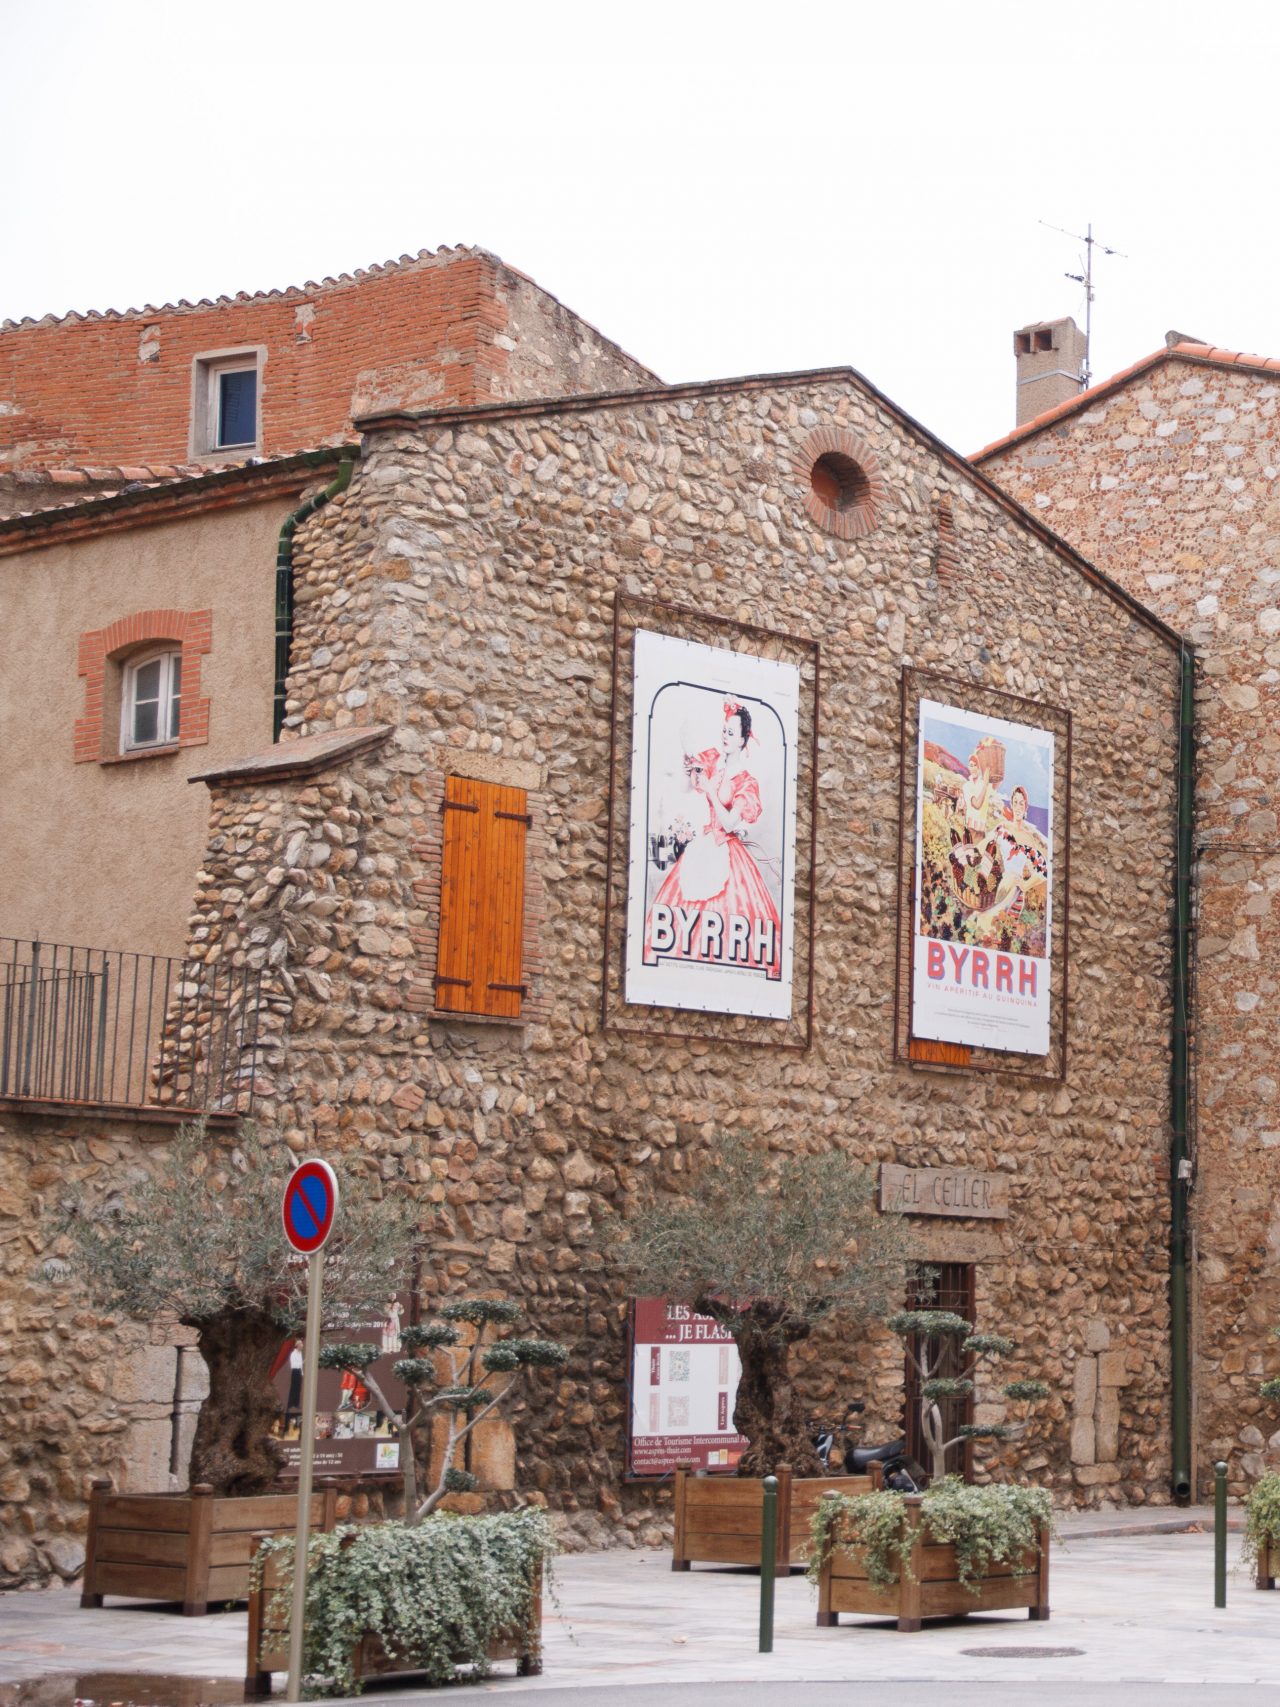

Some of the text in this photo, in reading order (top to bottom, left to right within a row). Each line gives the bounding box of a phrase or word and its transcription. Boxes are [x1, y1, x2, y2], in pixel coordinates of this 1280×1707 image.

[651, 903, 775, 966] BYRRH
[928, 940, 1038, 998] BYRRH
[928, 982, 941, 990] VIN
[982, 991, 993, 1000] AU
[996, 995, 1037, 1007] QUINQUINA
[902, 1174, 991, 1209] EL CELLER
[667, 1305, 690, 1320] LES
[679, 1324, 692, 1342] JE
[635, 1436, 653, 1447] Office
[655, 1437, 662, 1446] de
[664, 1437, 692, 1446] Tourisme
[693, 1435, 739, 1445] Intercommunal
